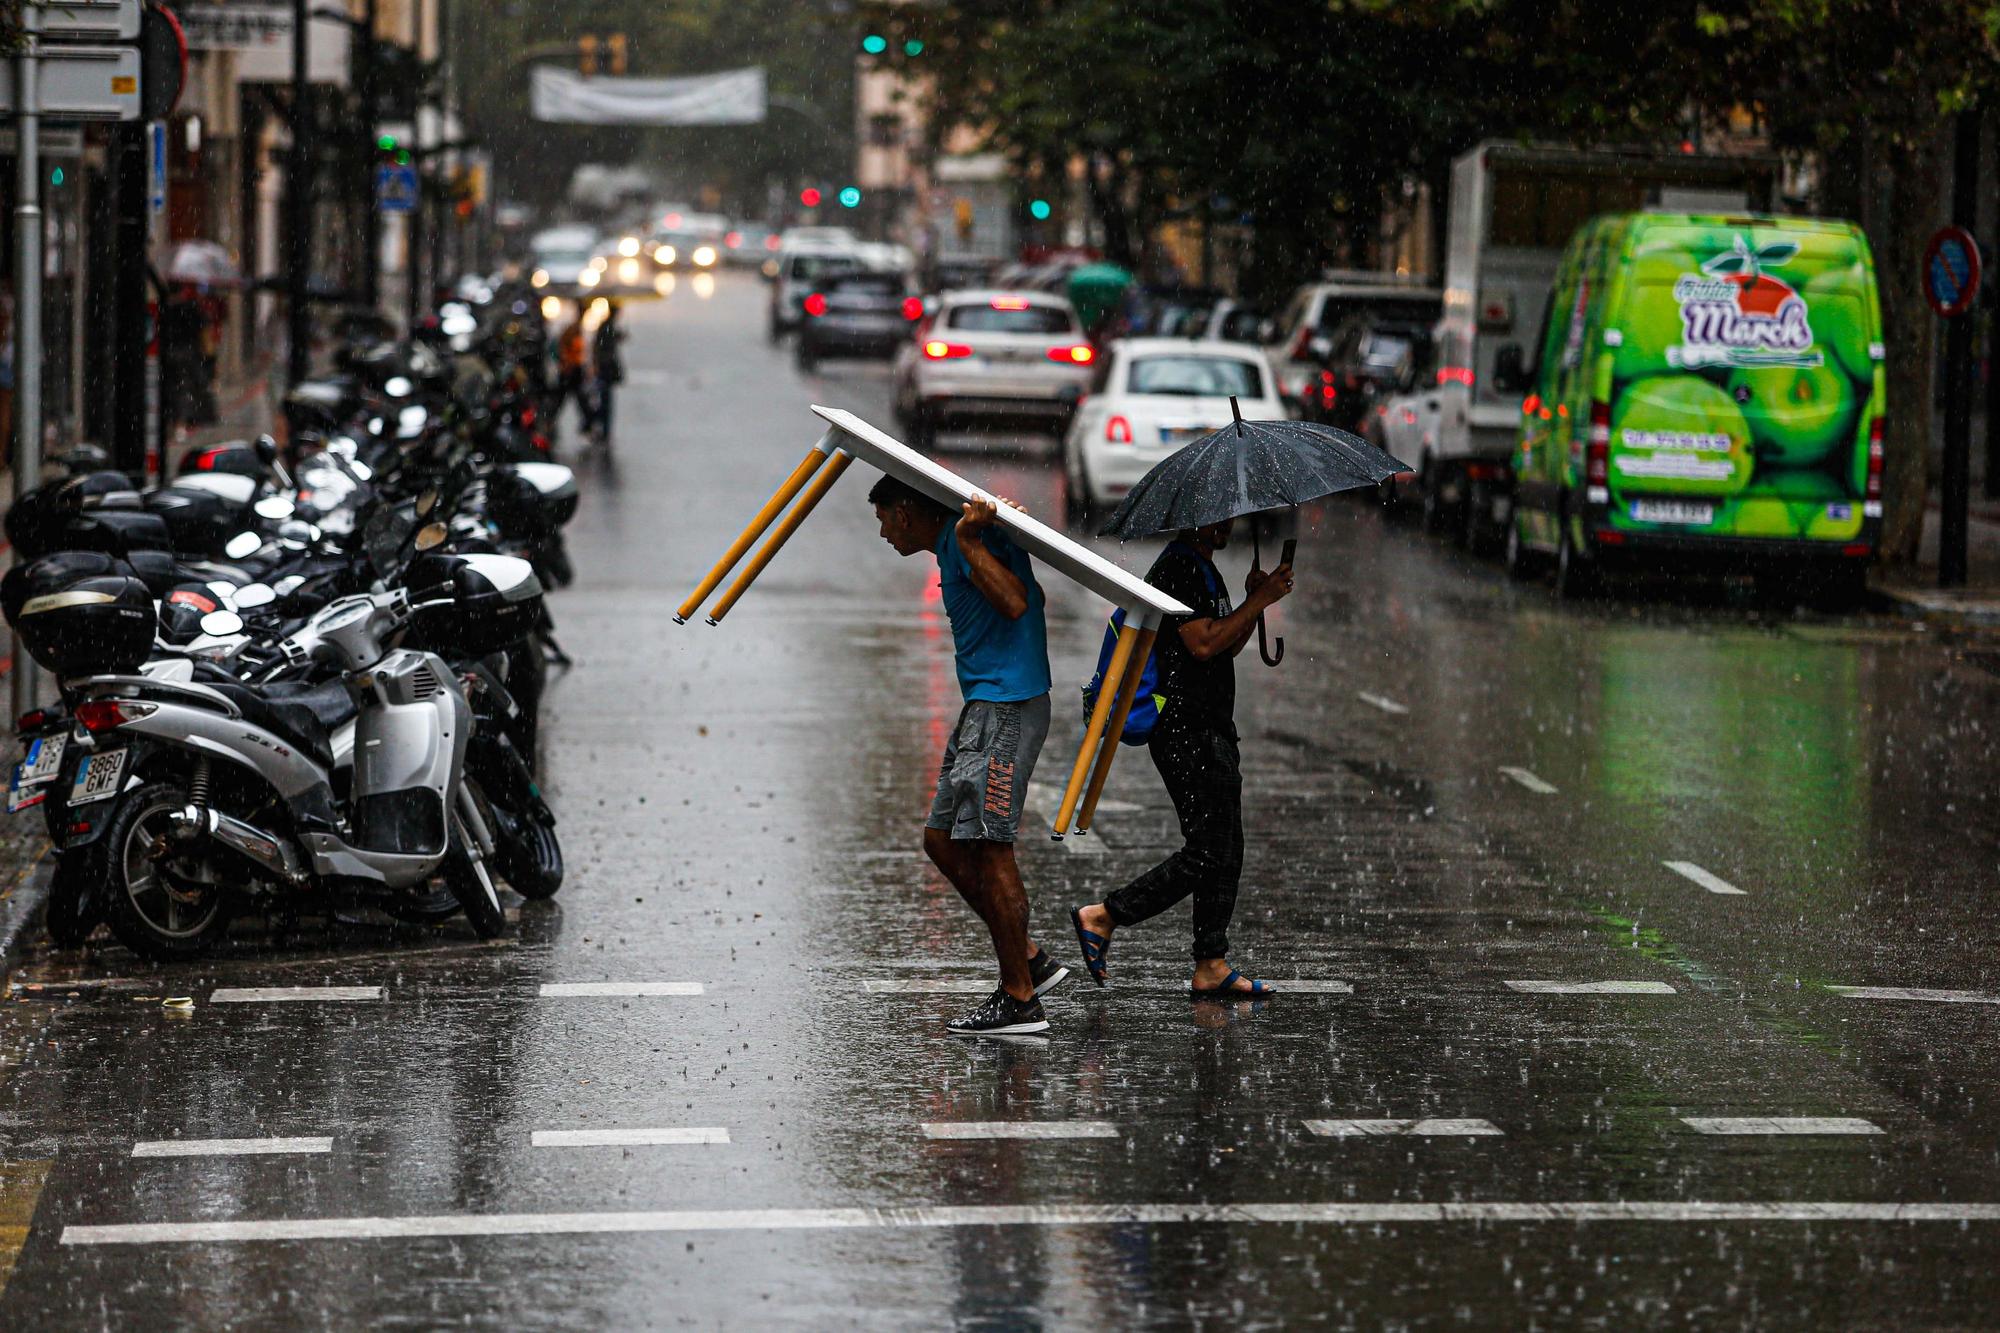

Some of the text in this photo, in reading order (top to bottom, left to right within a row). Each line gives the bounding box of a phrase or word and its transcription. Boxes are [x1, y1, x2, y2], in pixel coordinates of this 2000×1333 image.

[1685, 300, 1810, 347] March
[86, 769, 118, 793] GMF
[87, 752, 123, 776] 3860
[984, 754, 1014, 817] NIKE
